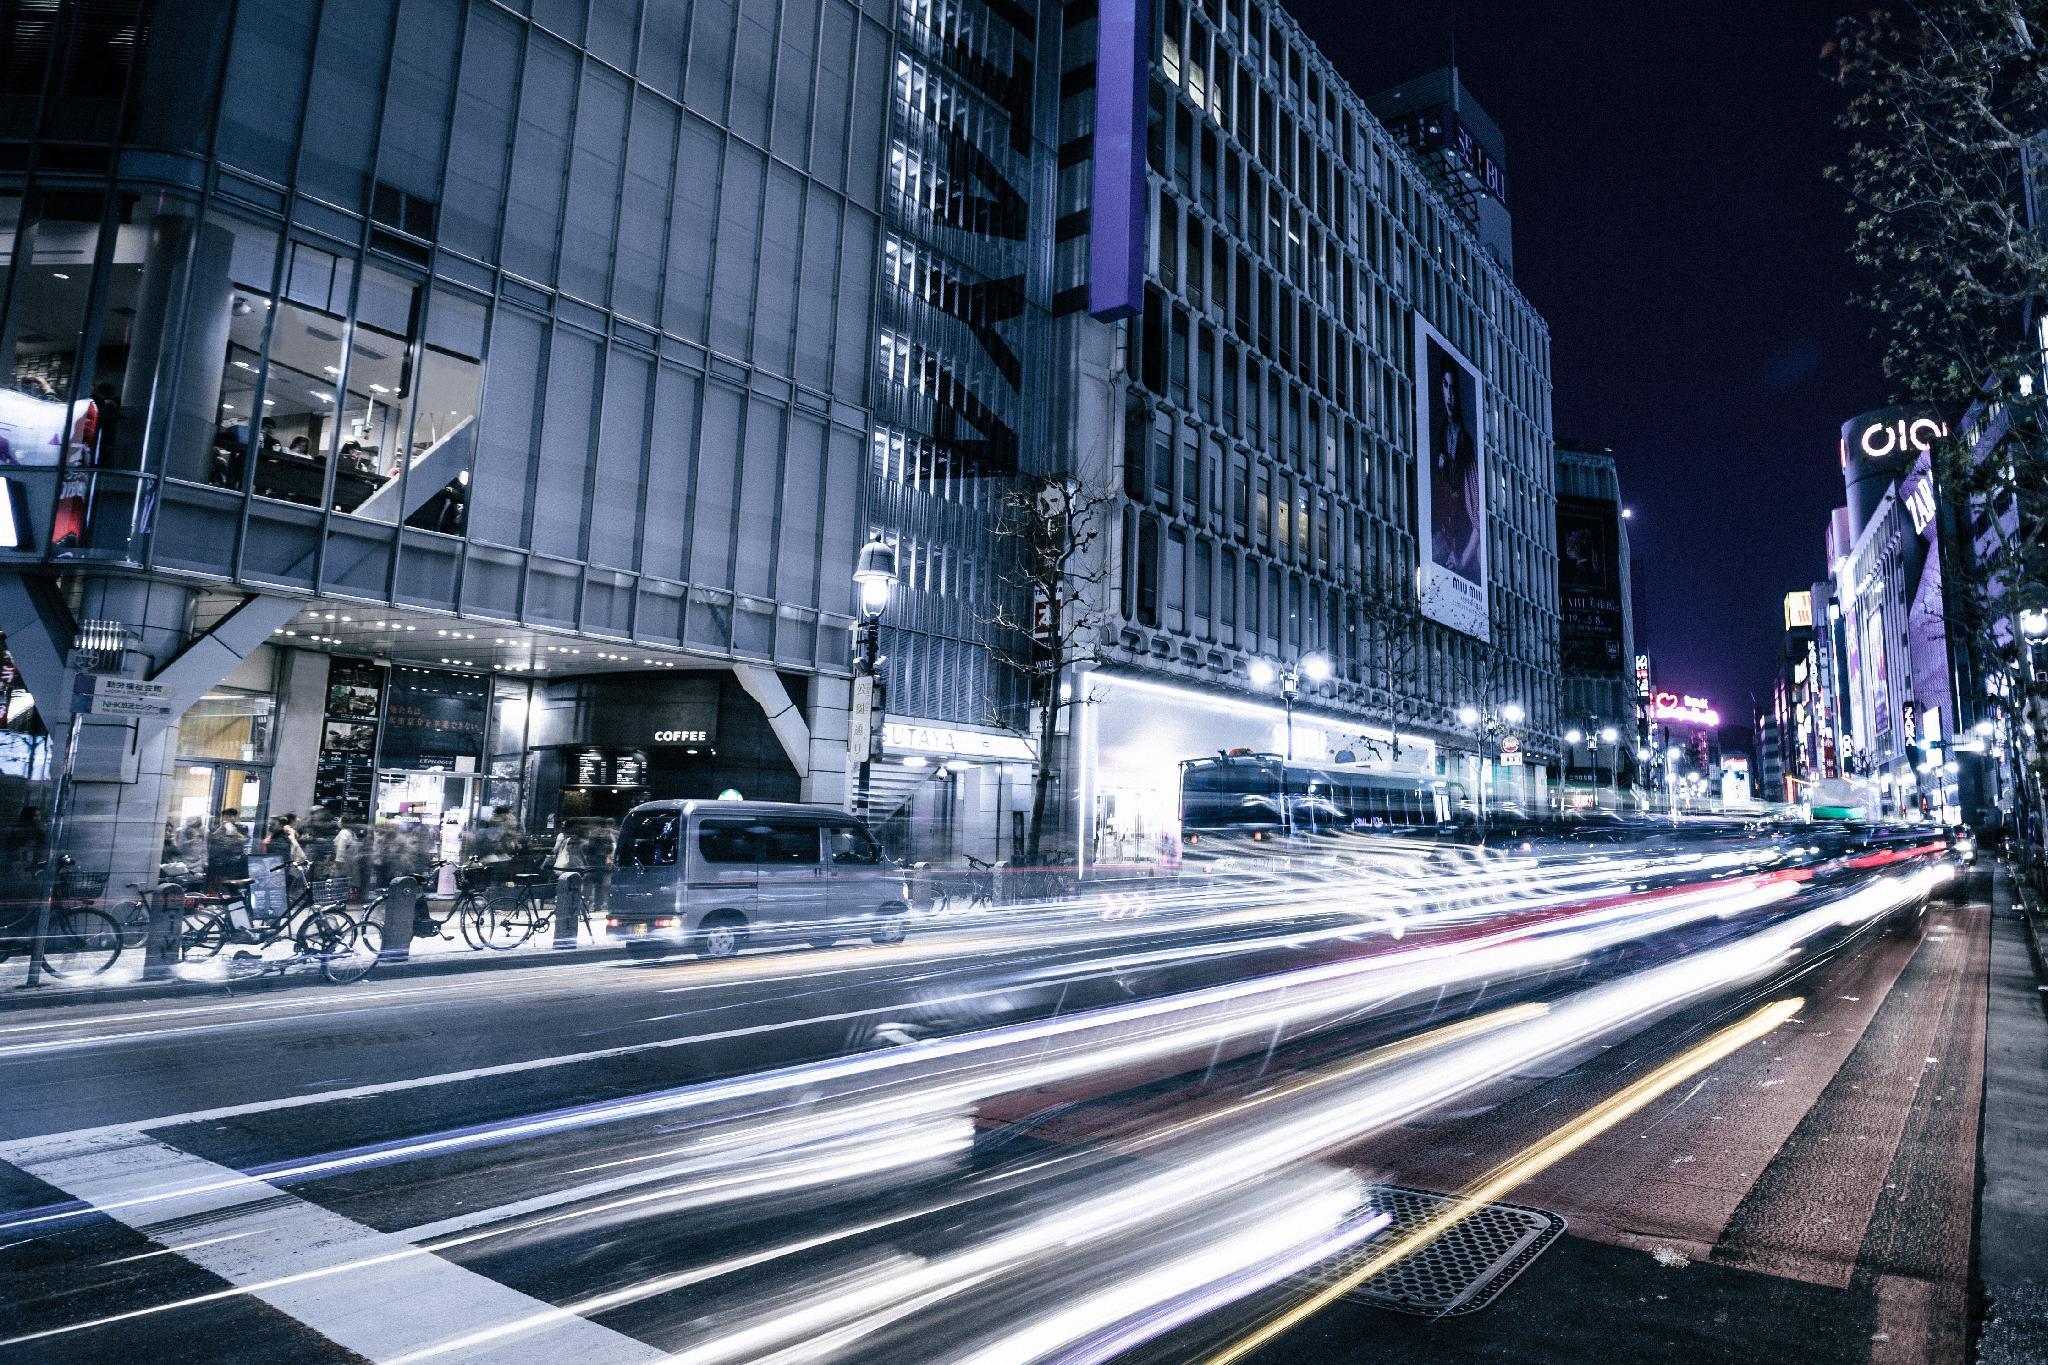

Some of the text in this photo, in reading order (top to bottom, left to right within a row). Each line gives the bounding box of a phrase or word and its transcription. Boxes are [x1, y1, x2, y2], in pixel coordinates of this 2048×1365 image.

[1905, 470, 1936, 535] ZAR
[654, 730, 707, 742] COFFEE
[854, 683, 867, 754] 公園通り
[1904, 705, 1917, 747] ZARA
